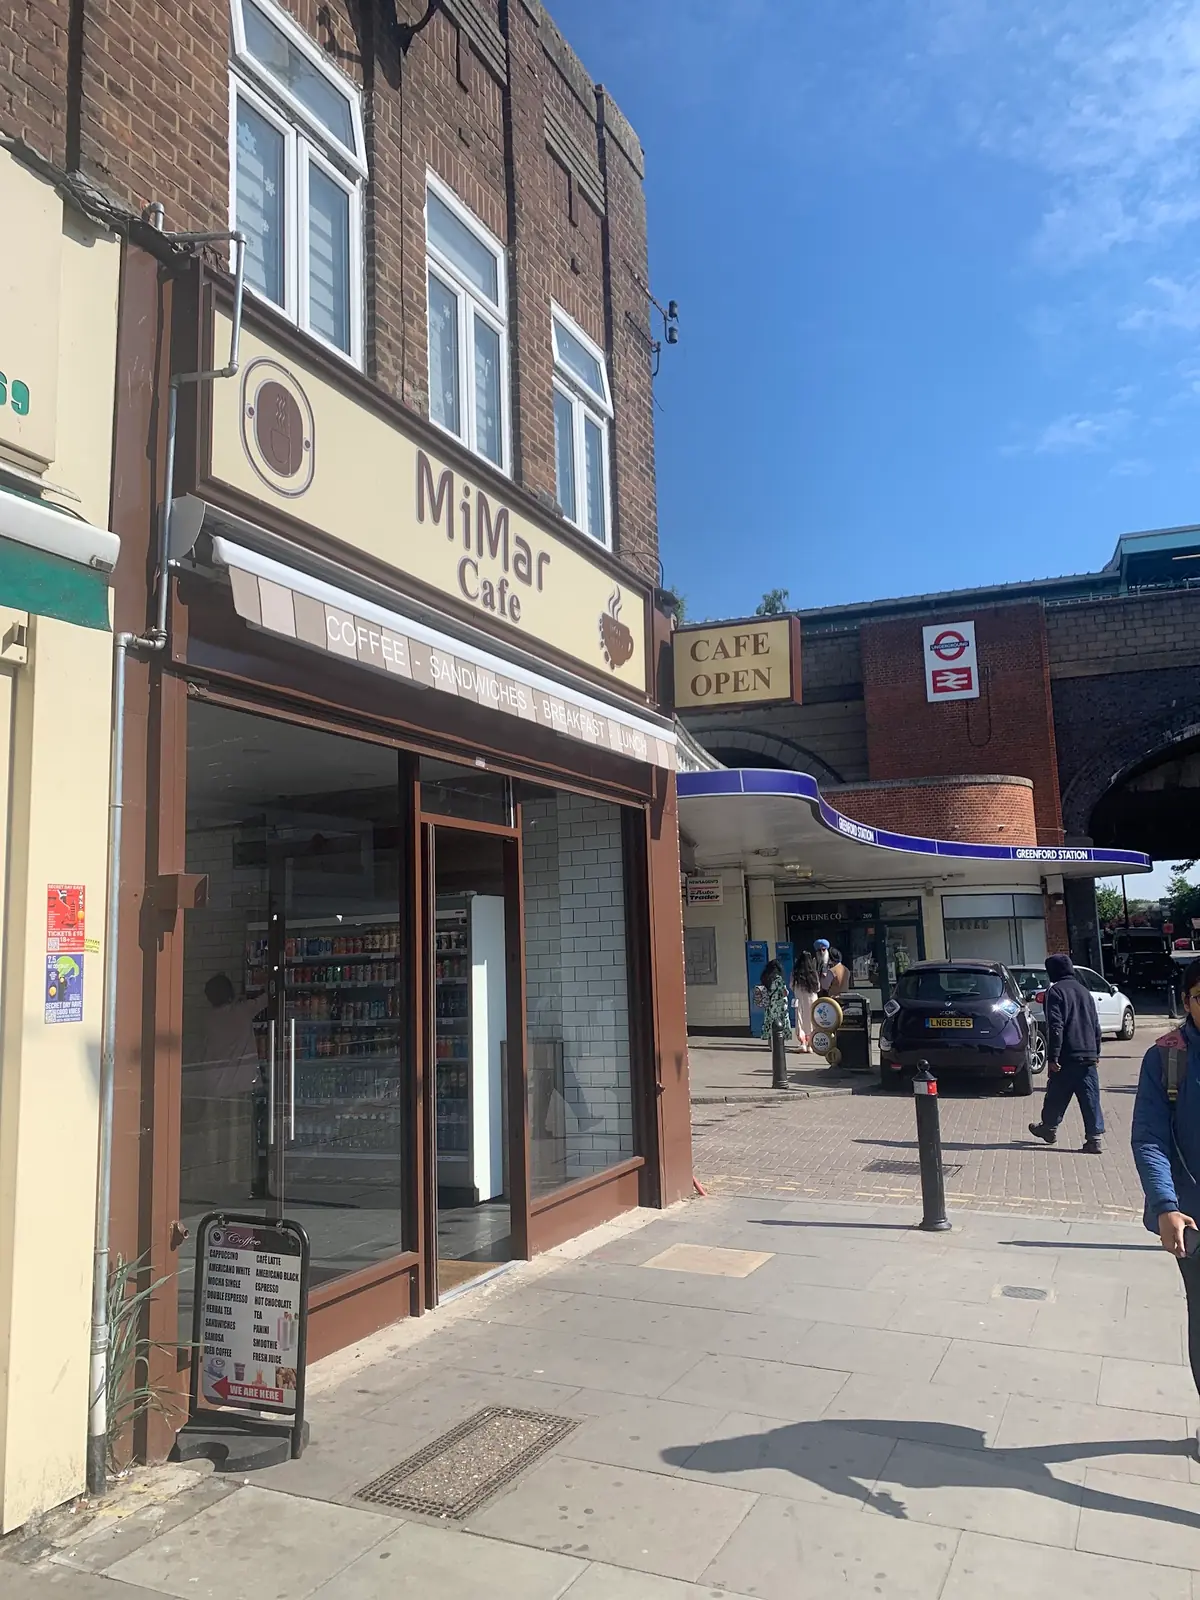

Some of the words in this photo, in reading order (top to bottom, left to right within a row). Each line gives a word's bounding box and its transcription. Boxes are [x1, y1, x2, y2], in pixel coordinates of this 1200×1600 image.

[416, 448, 551, 593] MiMar
[457, 555, 522, 624] Cafe
[690, 632, 771, 663] CAFE
[931, 641, 969, 650] UNDERGROUND
[326, 615, 406, 668] COFFEE
[429, 654, 528, 711] SANDWICHES
[543, 699, 605, 739] BREAKFAST
[616, 729, 648, 753] LUNCH
[690, 667, 773, 697] OPEN
[1016, 848, 1057, 860] GREENFORD
[1058, 849, 1088, 860] STATION
[790, 913, 829, 921] CAFFEINE
[829, 912, 842, 921] CO
[930, 1018, 953, 1027] LN68
[954, 1018, 972, 1027] EES
[225, 1231, 261, 1247] Coffee
[210, 1249, 238, 1260] CAPPUCCINO
[267, 1256, 281, 1266] LATTE
[209, 1263, 235, 1274] AMERICANO
[235, 1265, 250, 1275] WHITE
[256, 1269, 283, 1280] AMERICANO
[283, 1272, 299, 1281] BLACK
[208, 1277, 224, 1286] MOCHA
[225, 1279, 240, 1288] SINGLE
[255, 1282, 279, 1293] ESPRESSO
[207, 1290, 224, 1301] DOUBLE
[224, 1292, 248, 1303] ESPRESSO
[255, 1296, 264, 1305] HOT
[264, 1297, 291, 1309] CHOCOLATE
[206, 1304, 223, 1314] HERBAL
[223, 1306, 232, 1315] TEA
[254, 1310, 262, 1320] TEA
[205, 1318, 236, 1330] SANDWICHES
[253, 1324, 269, 1334] PANINI
[205, 1331, 224, 1342] SAMOSA
[253, 1338, 277, 1350] SMOOTHIE
[215, 1347, 231, 1357] COFFEE
[253, 1352, 268, 1362] FRESH
[268, 1354, 282, 1364] JUICE
[230, 1384, 242, 1395] WE
[243, 1387, 258, 1398] ARE
[259, 1389, 279, 1400] HERE
